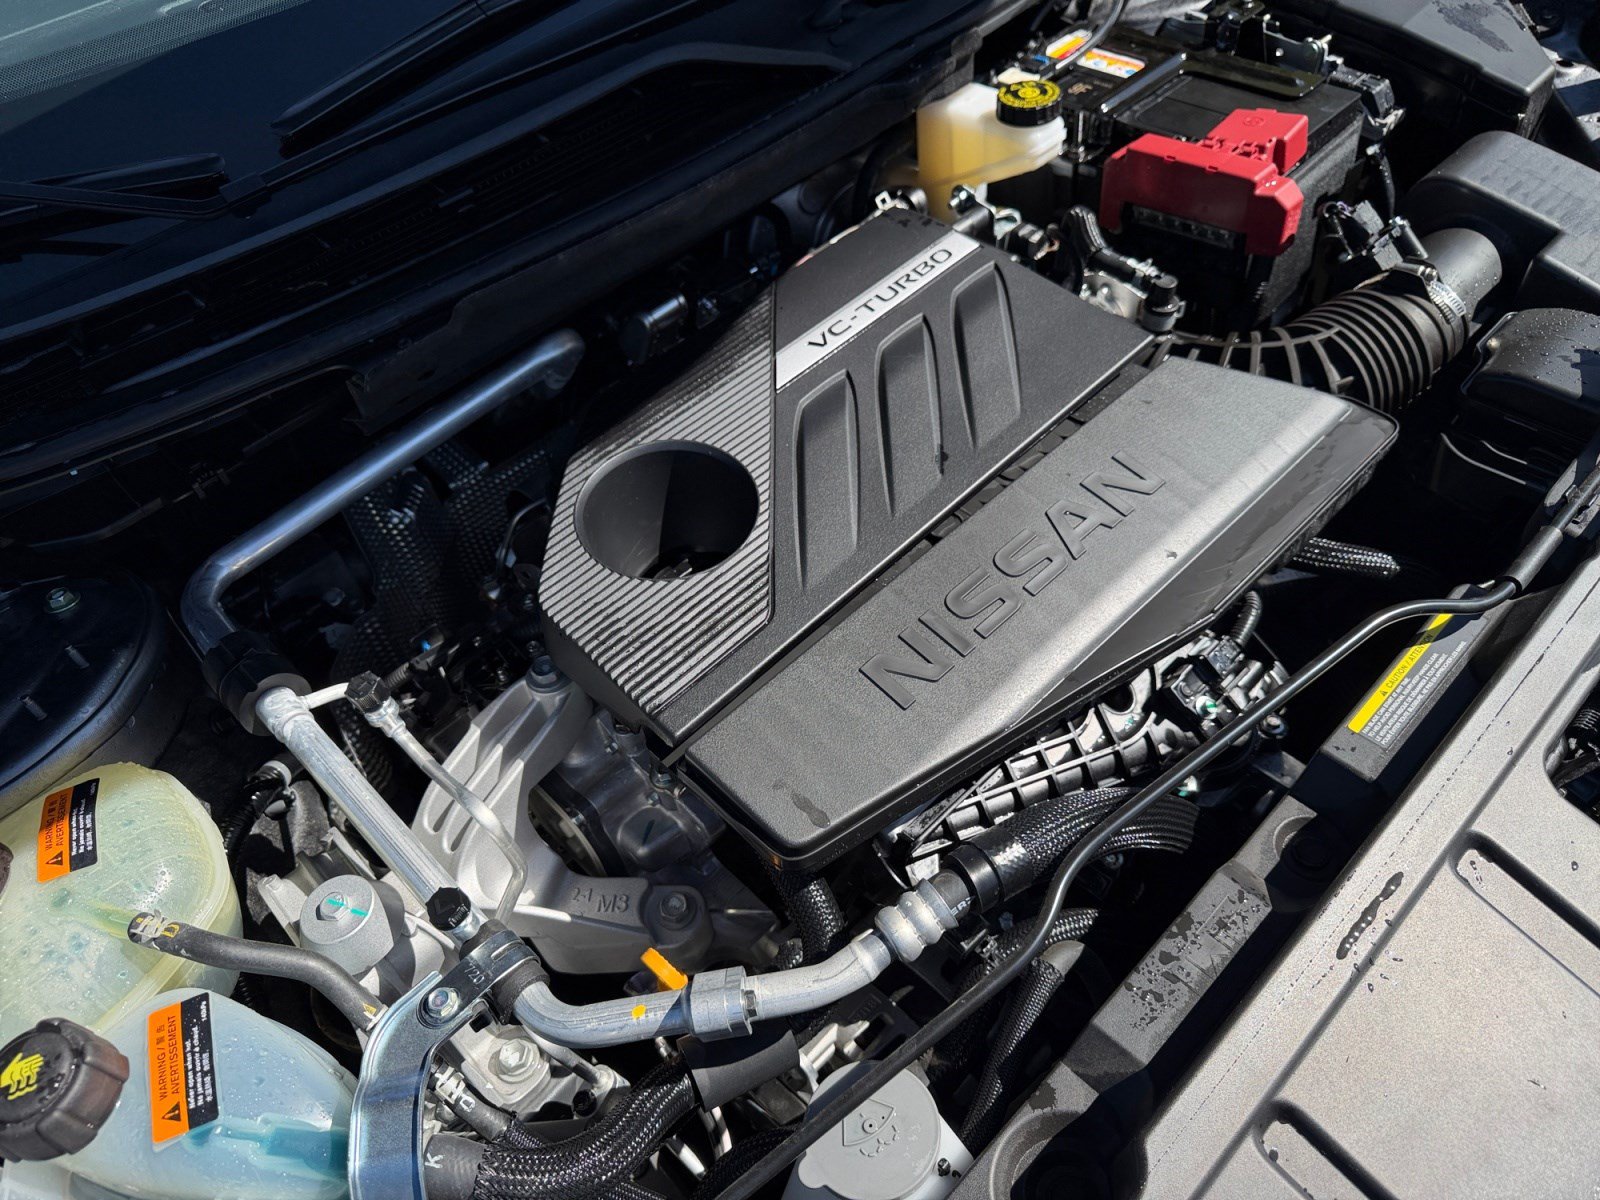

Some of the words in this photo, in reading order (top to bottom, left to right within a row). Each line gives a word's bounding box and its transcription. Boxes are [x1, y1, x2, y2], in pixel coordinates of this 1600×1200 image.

[806, 248, 953, 350] VC-TURBO
[857, 450, 1166, 711] NISSAN
[1385, 664, 1408, 689] CAUTION
[596, 892, 631, 913] M3
[157, 1050, 168, 1101] WARNING
[167, 1015, 180, 1095] AVERTISSEMENT
